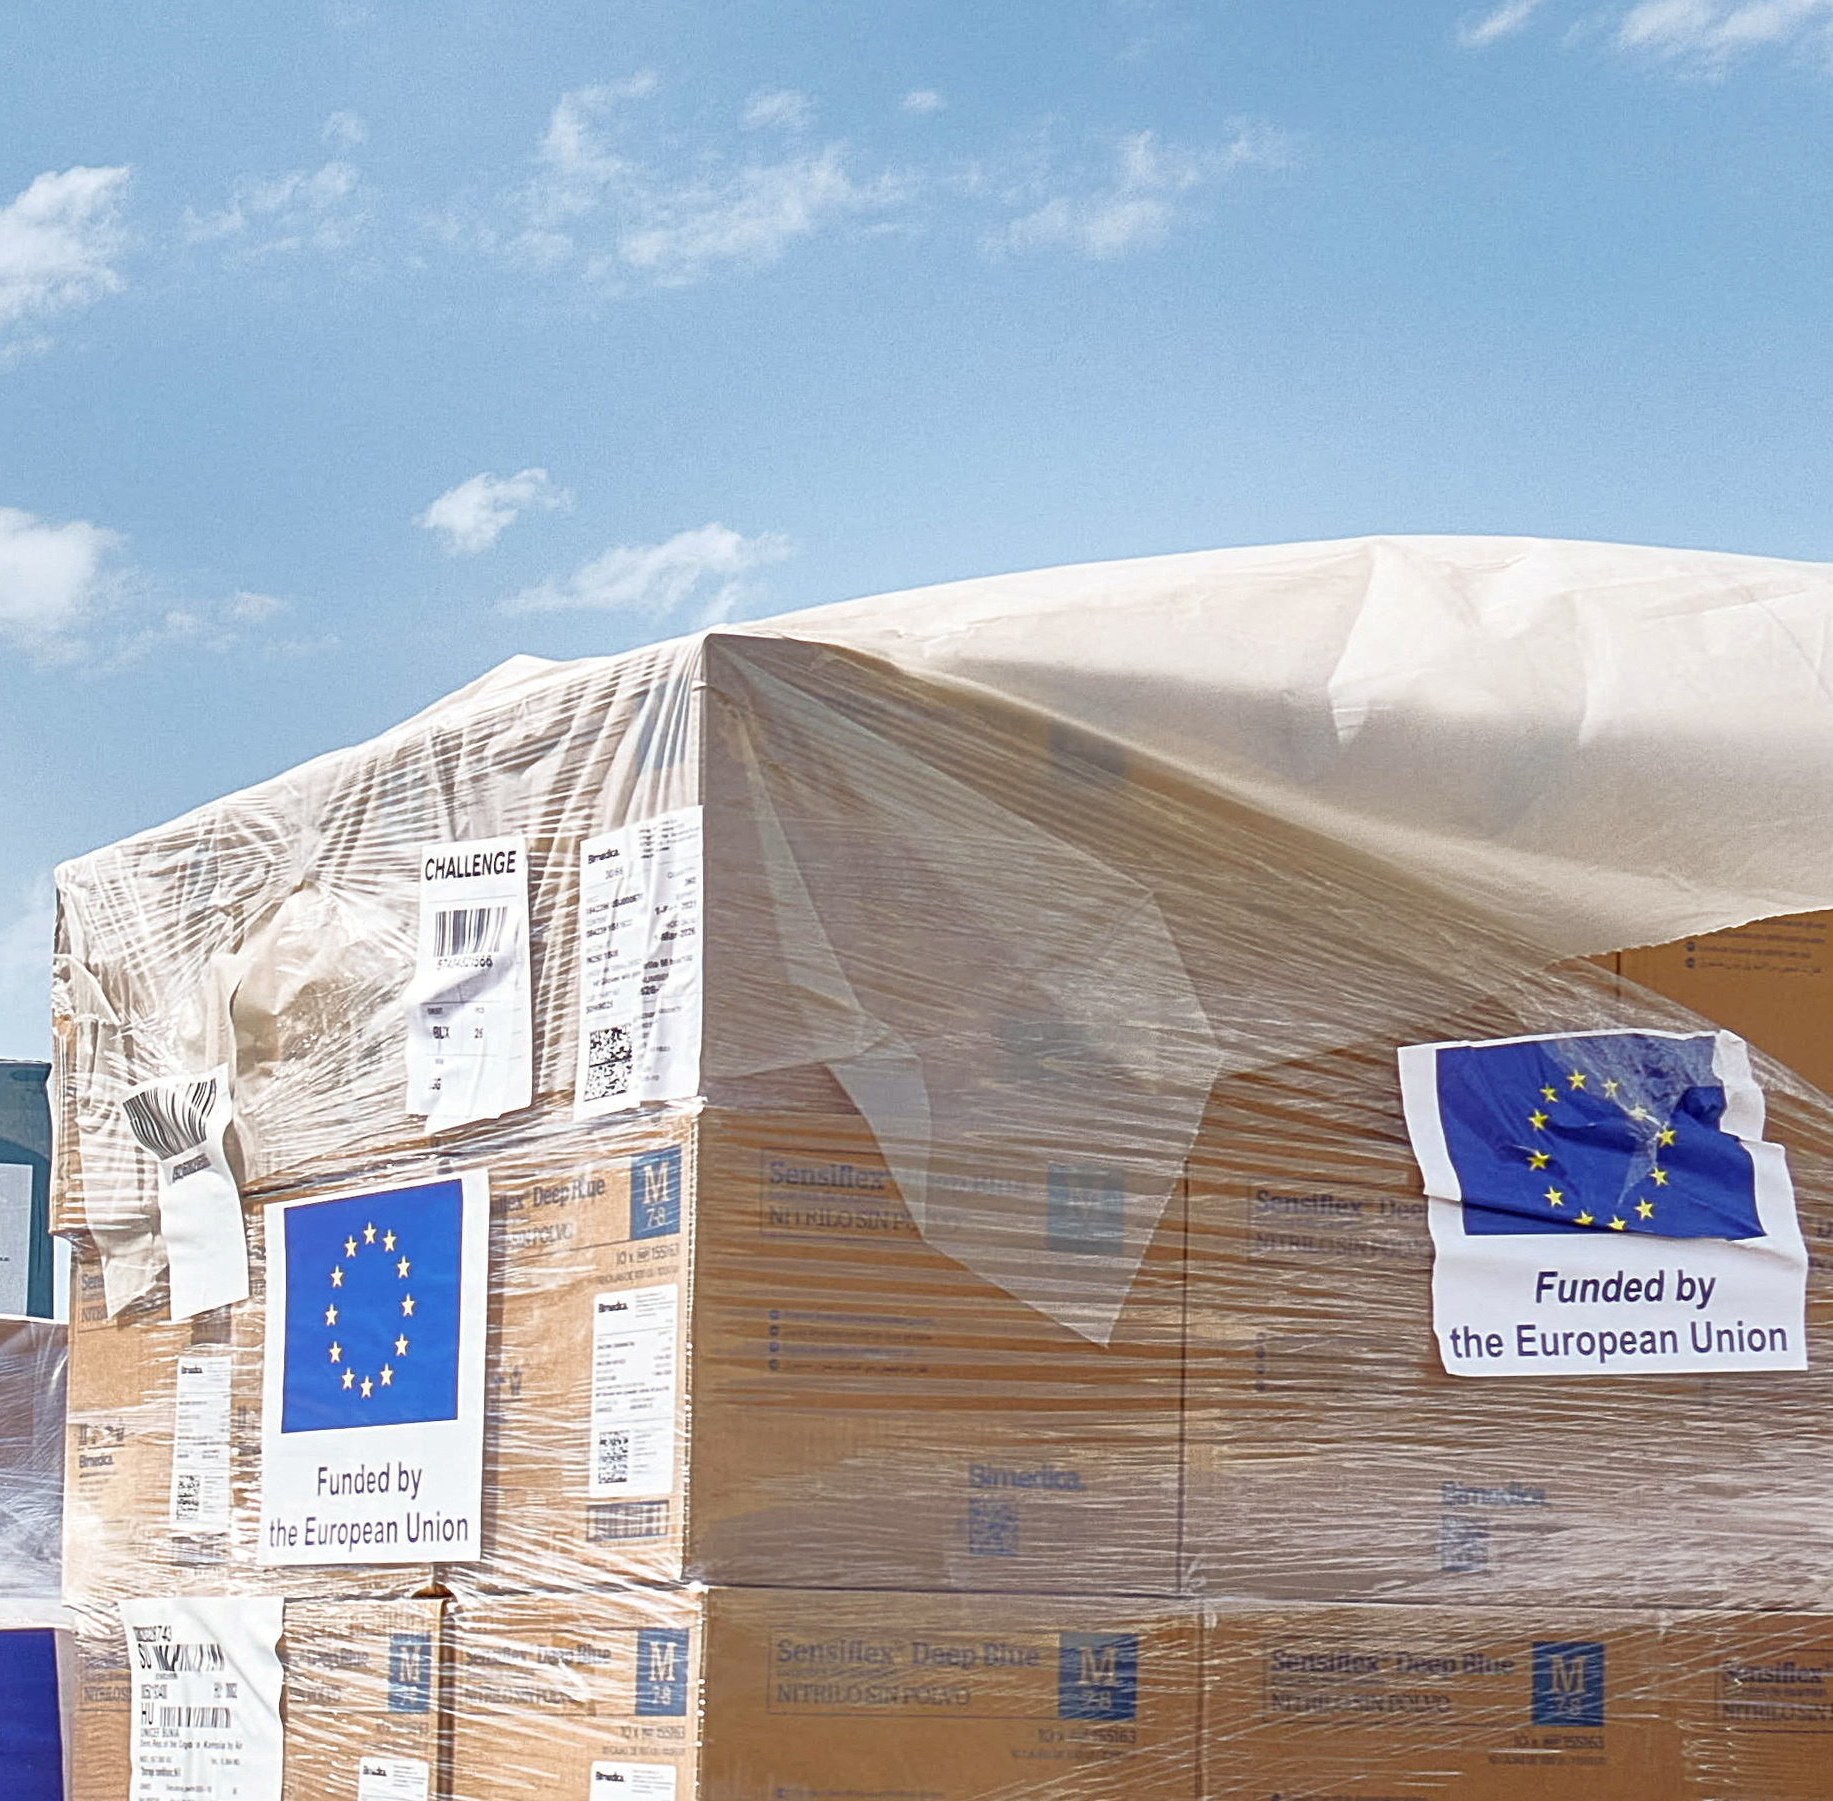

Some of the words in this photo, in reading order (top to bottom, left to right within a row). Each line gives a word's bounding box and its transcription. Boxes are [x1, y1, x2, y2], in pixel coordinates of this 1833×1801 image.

[425, 851, 517, 880] CHALLENGE
[643, 1161, 670, 1204] M
[769, 1161, 887, 1191] Sensiflex
[1535, 1270, 1665, 1304] Funded
[1676, 1270, 1716, 1309] by
[1450, 1326, 1504, 1359] the
[1517, 1323, 1678, 1363] European
[1691, 1322, 1788, 1354] Union
[317, 1464, 391, 1498] Funded
[397, 1461, 423, 1499] by
[269, 1521, 298, 1547] the
[304, 1518, 400, 1553] European
[405, 1512, 469, 1543] Union
[398, 1649, 421, 1682] M
[649, 1642, 676, 1682] M
[777, 1639, 896, 1665] Sensiflex
[912, 1642, 976, 1668] Deep
[1078, 1647, 1117, 1686] M
[1551, 1656, 1585, 1693] M
[777, 1684, 862, 1705] NITRILO
[865, 1686, 902, 1706] SIN
